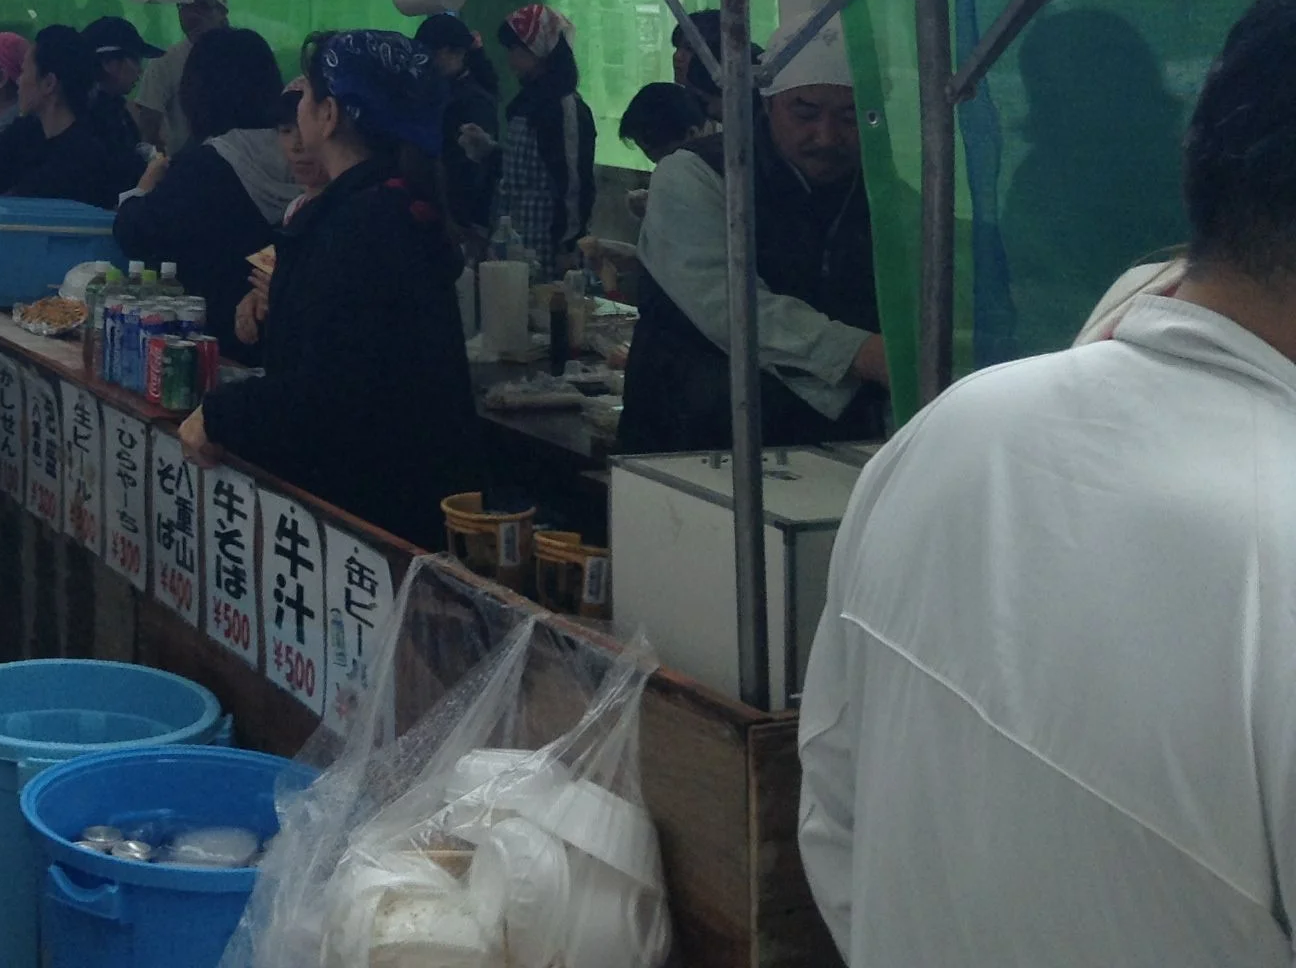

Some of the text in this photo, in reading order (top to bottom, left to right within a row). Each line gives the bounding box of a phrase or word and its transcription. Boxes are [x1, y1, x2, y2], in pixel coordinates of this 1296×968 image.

[213, 478, 248, 601] 牛そば
[273, 514, 315, 644] 牛汁
[212, 596, 250, 652] ¥500
[273, 638, 316, 698] ¥500
